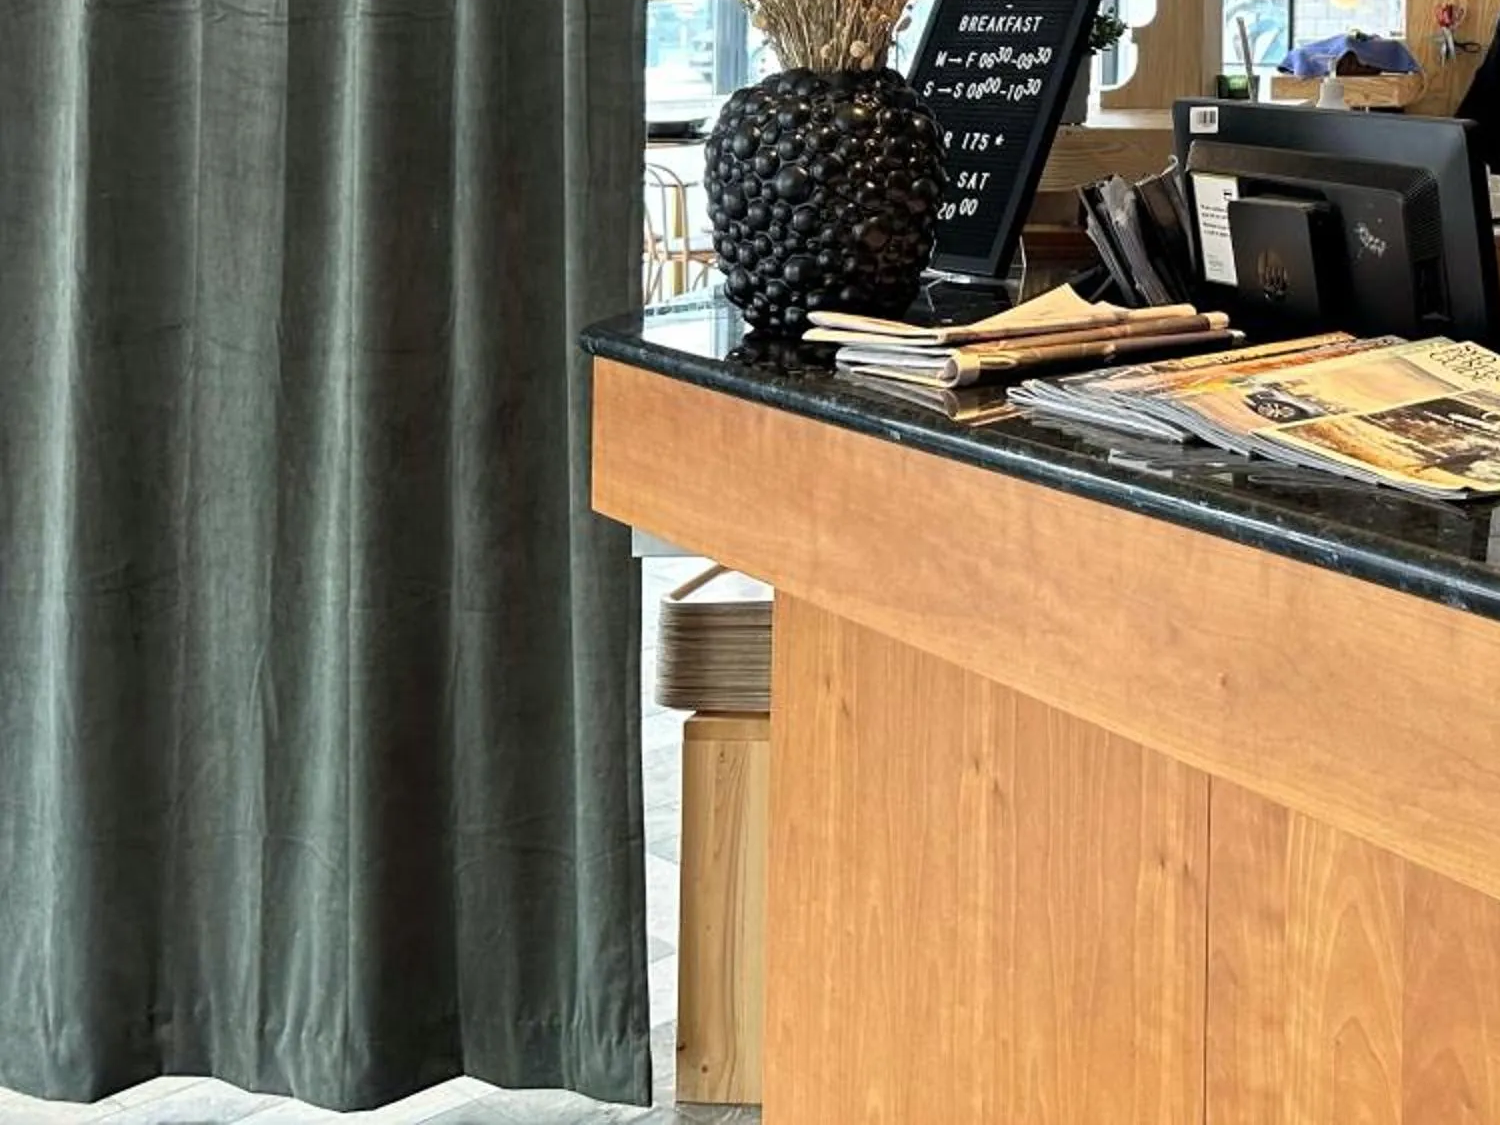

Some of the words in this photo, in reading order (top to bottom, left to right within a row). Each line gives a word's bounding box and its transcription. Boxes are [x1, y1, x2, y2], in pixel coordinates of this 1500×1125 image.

[958, 14, 1043, 33] BREAKFAST
[961, 132, 991, 151] 175
[957, 171, 991, 191] SAT
